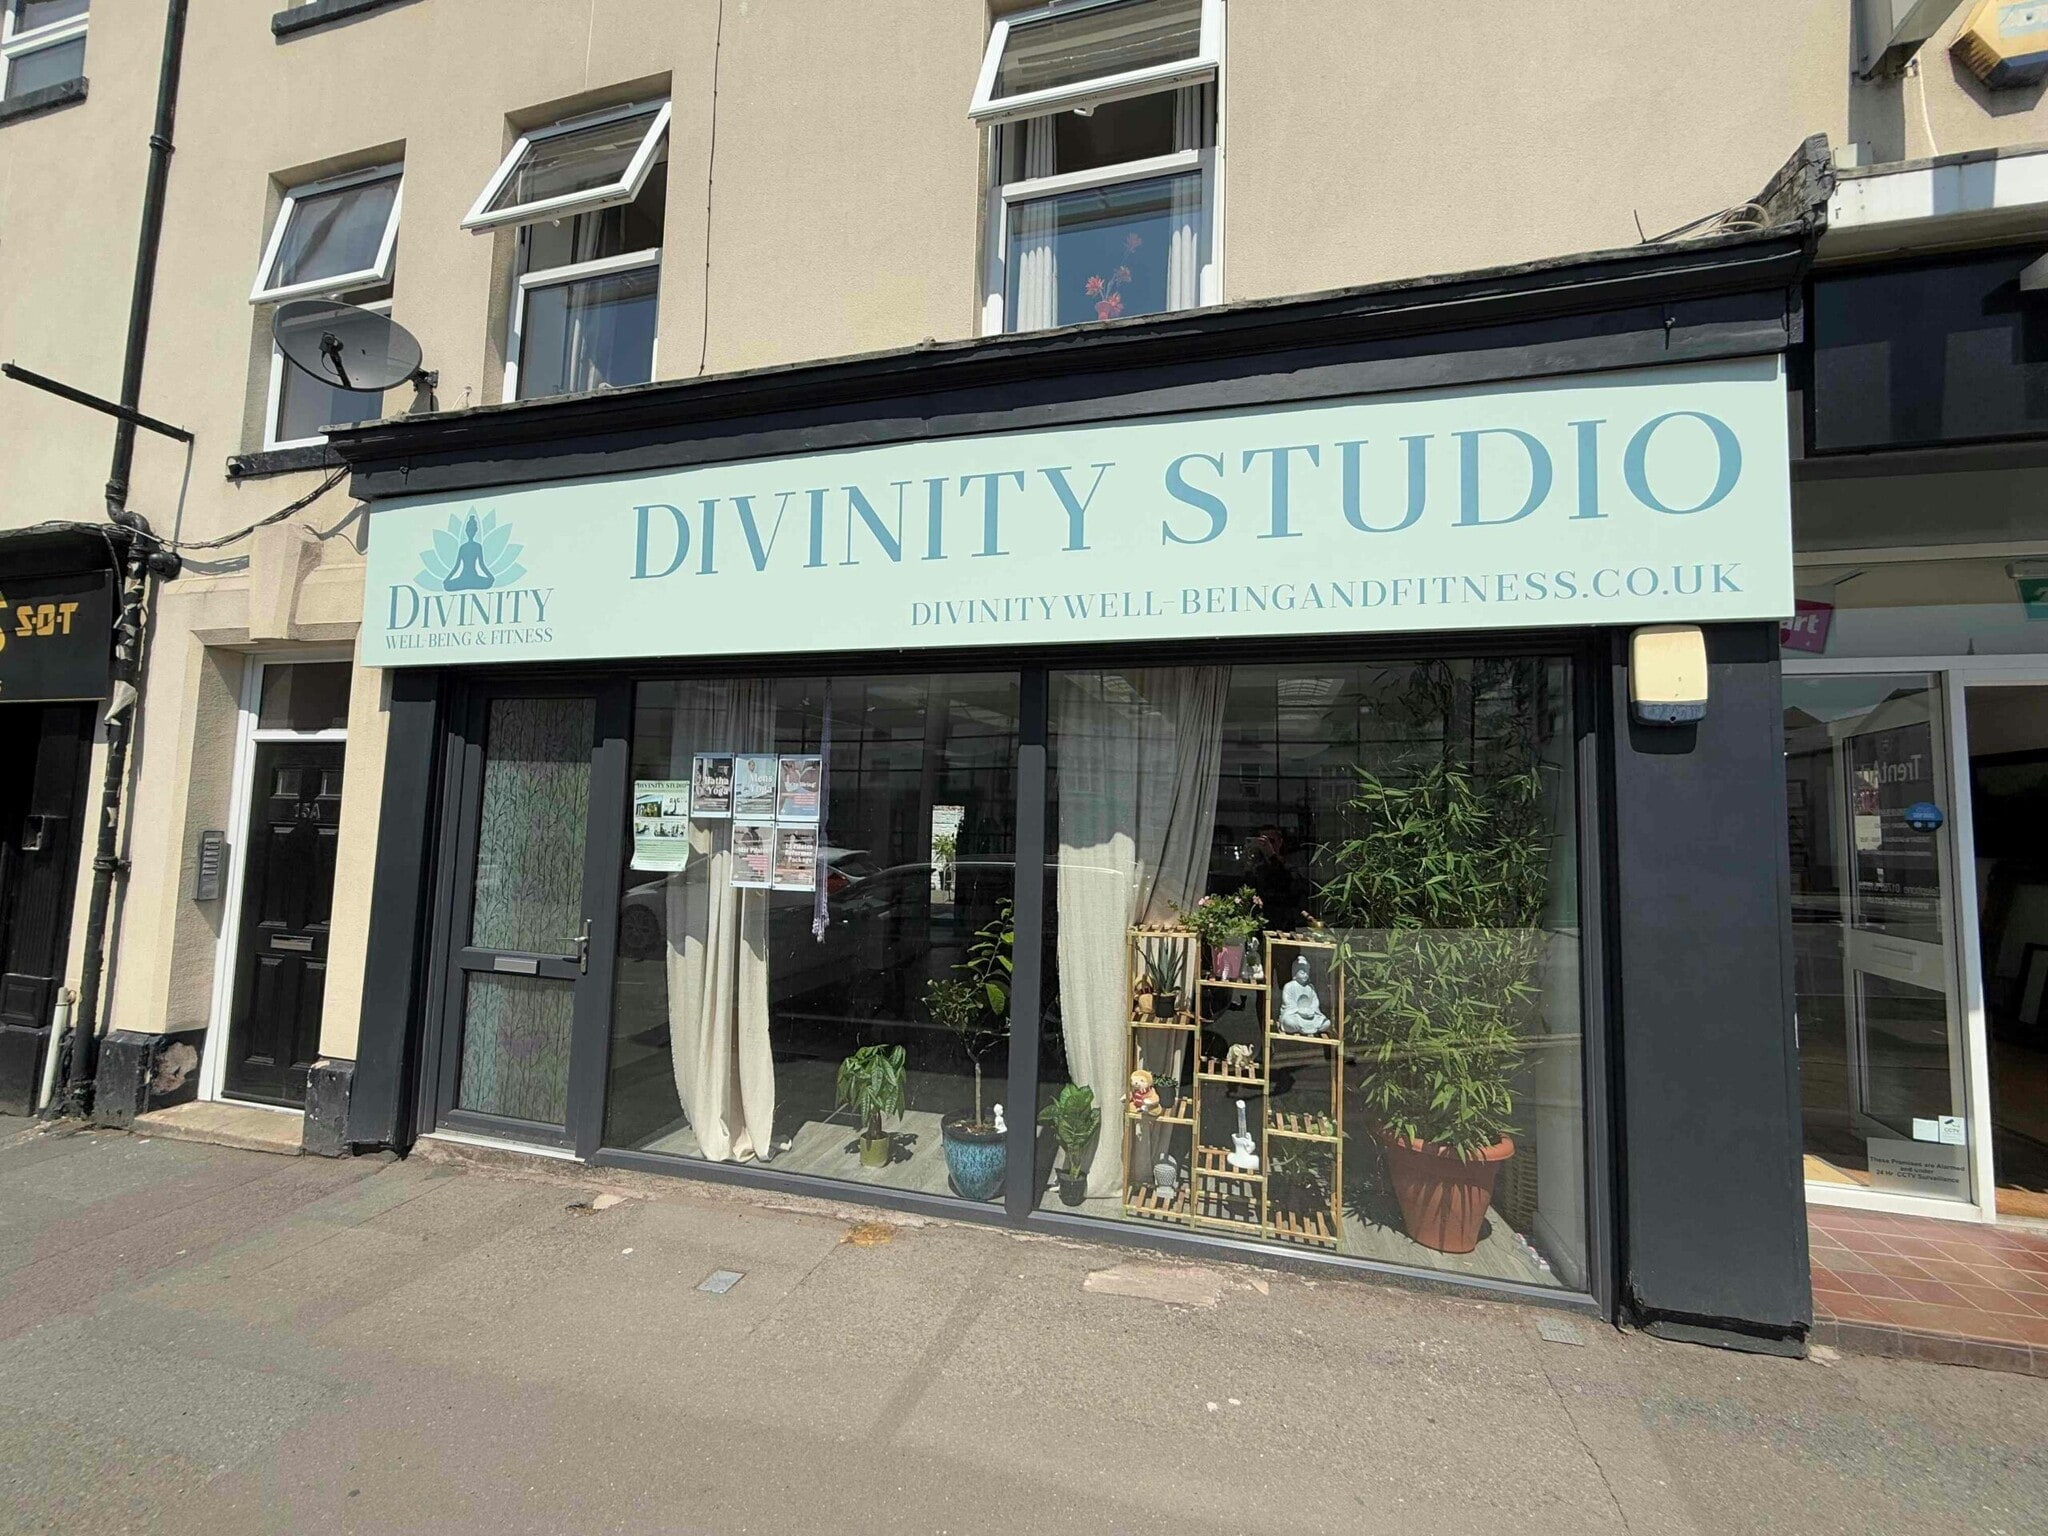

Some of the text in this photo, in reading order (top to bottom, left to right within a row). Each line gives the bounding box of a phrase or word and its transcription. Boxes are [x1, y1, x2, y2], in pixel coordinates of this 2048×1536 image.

[630, 411, 1744, 581] DIVINITY STUDIO
[912, 562, 1744, 628] DIVINITYWELL-BEINGANDFITNESS.CO.UK
[386, 584, 554, 630] DIVINITY
[385, 628, 553, 650] WELL-BEING & FITNESS
[704, 776, 729, 785] Hatha
[749, 773, 773, 783] Mens
[707, 785, 729, 797] Yoga
[750, 784, 773, 796] Yoga
[1870, 1156, 1890, 1164] These
[1936, 1163, 1965, 1172] Alarmed
[1897, 1171, 1916, 1179] CCTV
[1914, 1167, 1934, 1175] under
